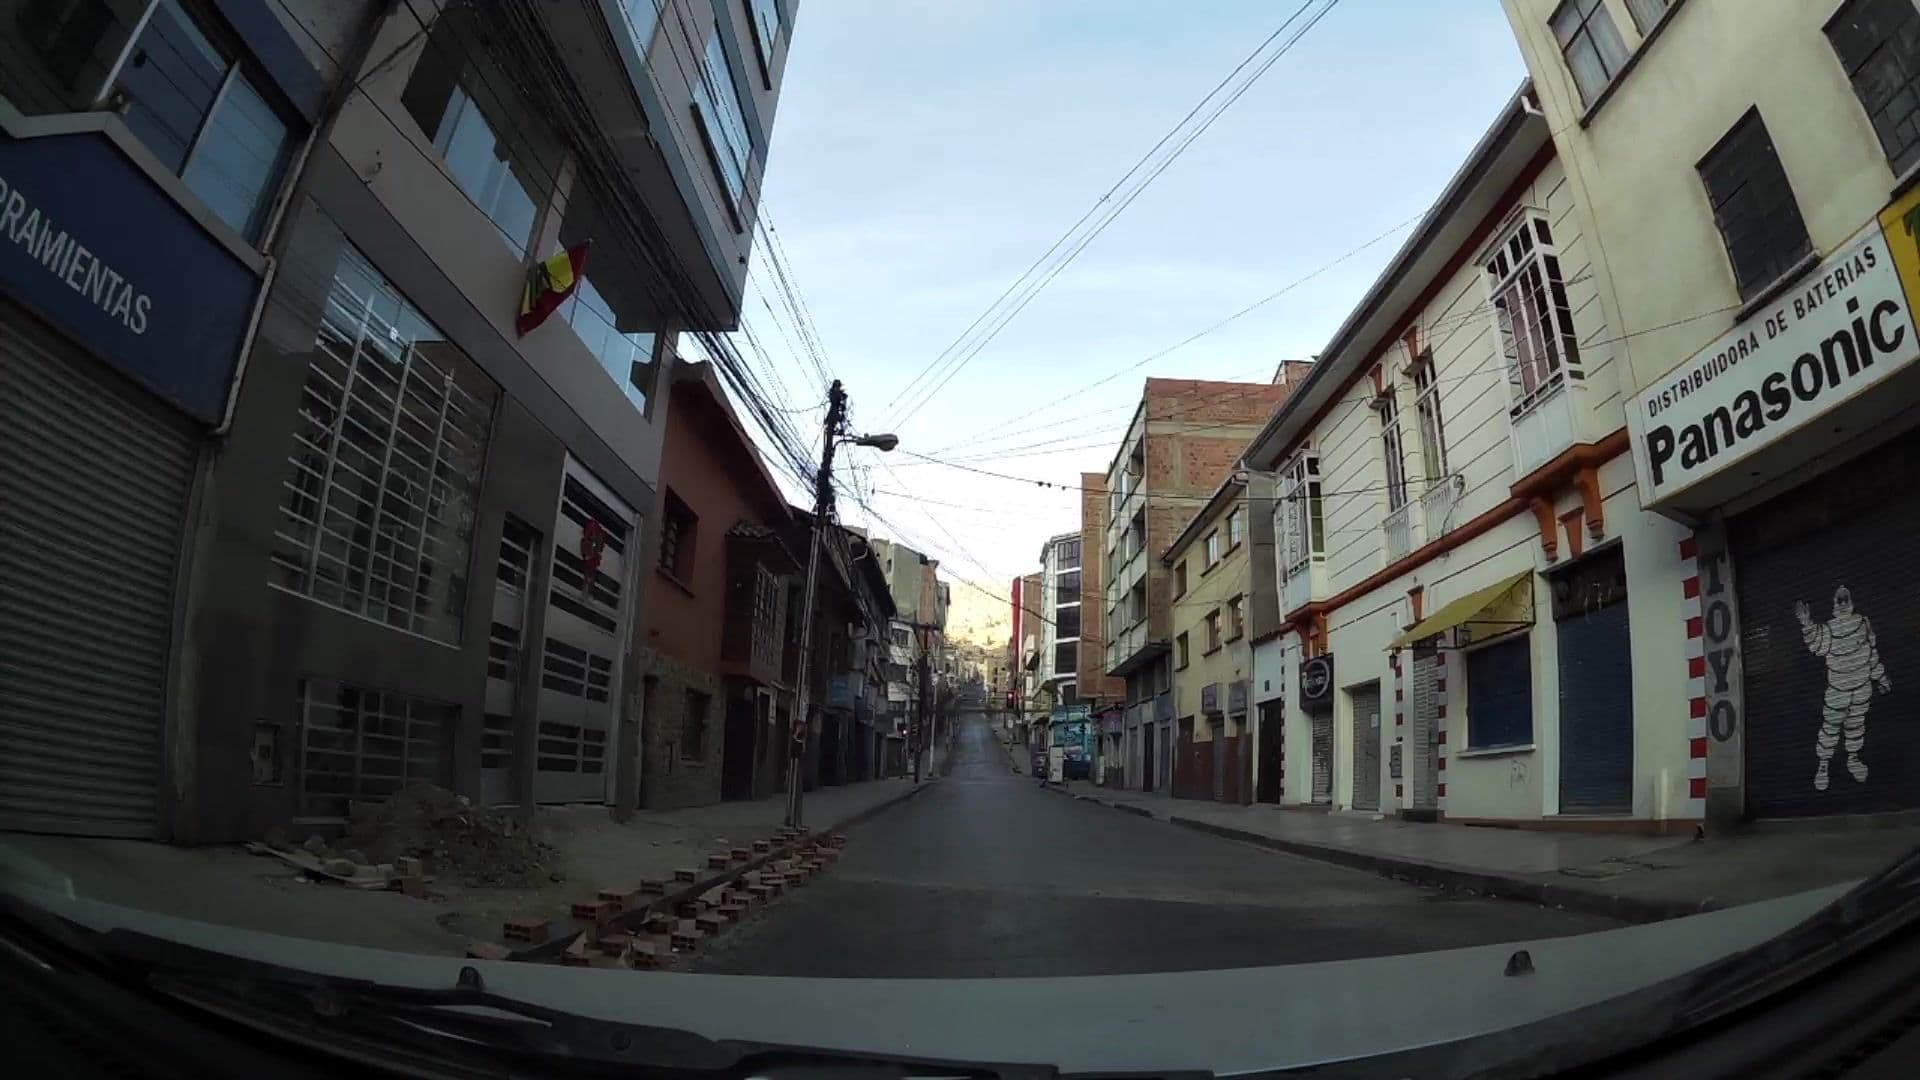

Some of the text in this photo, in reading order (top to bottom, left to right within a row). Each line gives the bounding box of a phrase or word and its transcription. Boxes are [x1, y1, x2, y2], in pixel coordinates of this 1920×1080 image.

[1646, 296, 1905, 486] Panasonic
[1648, 246, 1877, 417] DISTRIBUIDORA DE BATERIAS
[1699, 553, 1737, 742] TOYO
